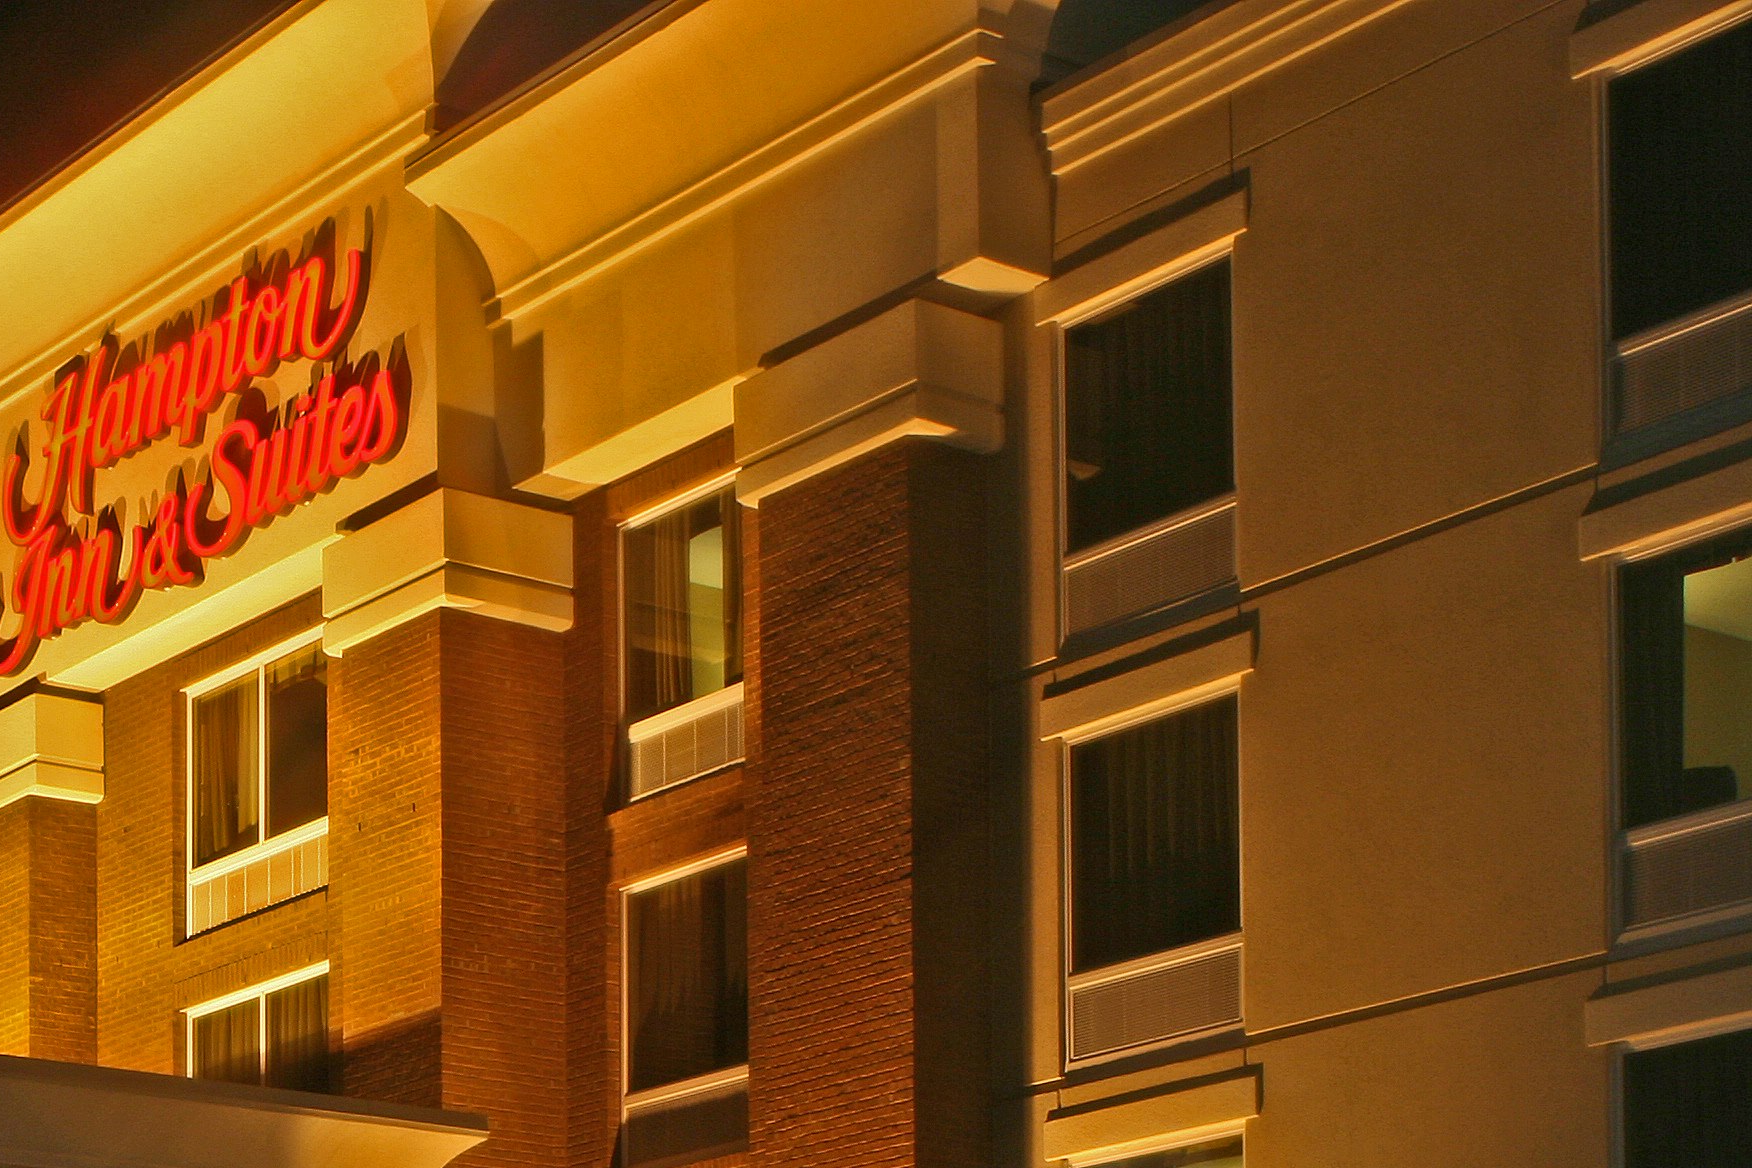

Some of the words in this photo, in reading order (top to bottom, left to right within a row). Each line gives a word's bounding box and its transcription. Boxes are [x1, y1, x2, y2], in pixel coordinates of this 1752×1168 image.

[3, 247, 363, 547] Hampton
[140, 492, 195, 591] &
[184, 369, 401, 559] Suites
